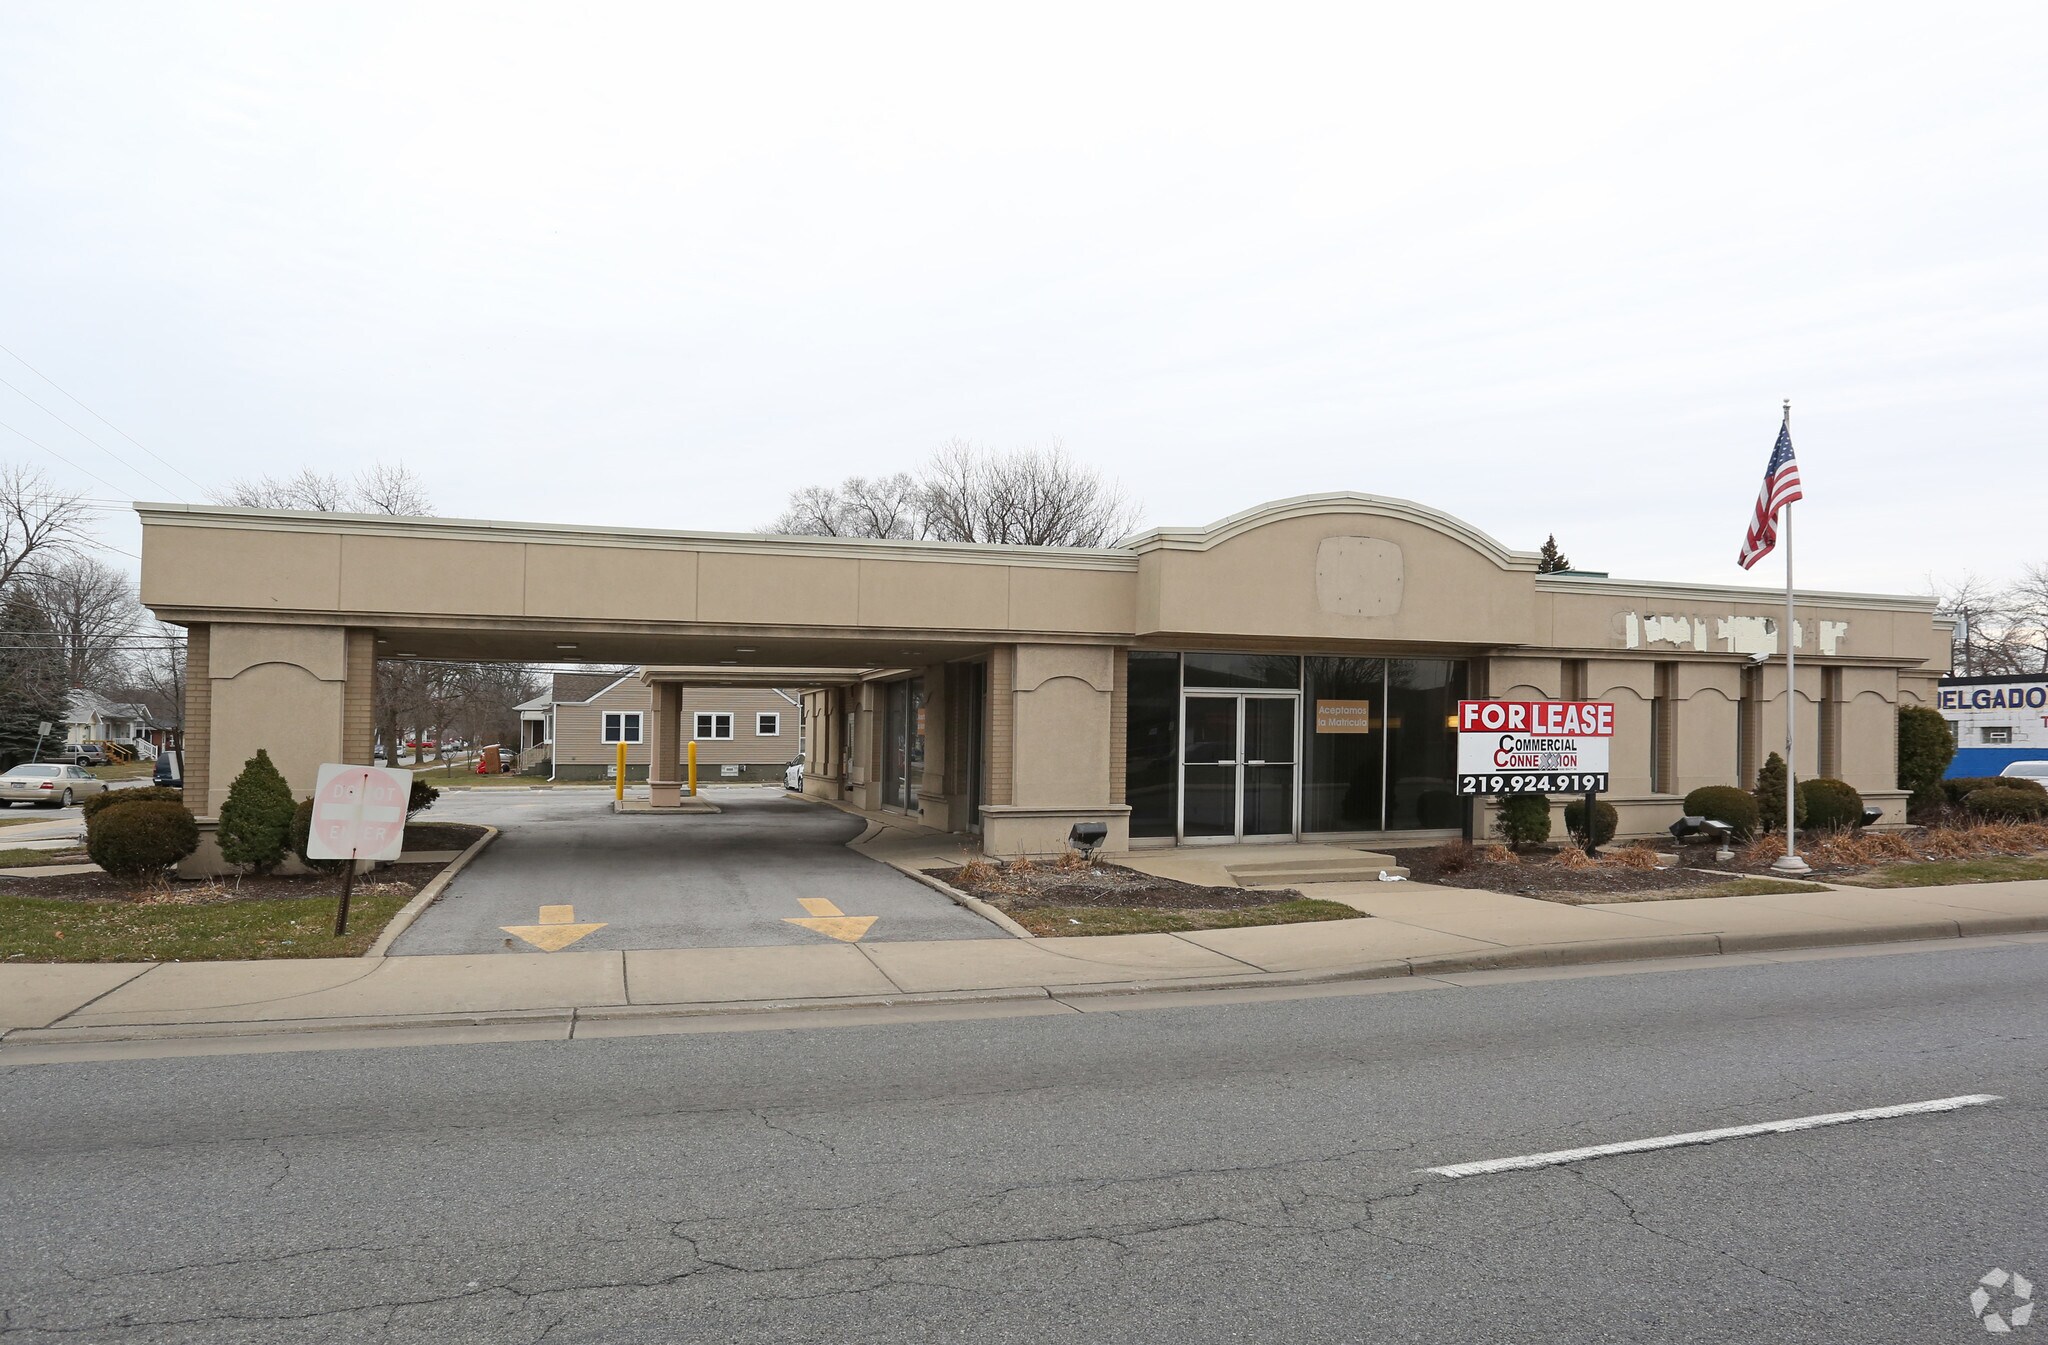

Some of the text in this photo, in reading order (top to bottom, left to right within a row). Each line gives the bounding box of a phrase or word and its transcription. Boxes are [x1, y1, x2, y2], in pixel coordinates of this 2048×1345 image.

[1937, 686, 2048, 709] ELGADO
[1318, 706, 1367, 715] Aceptamos
[1464, 703, 1613, 734] FOR LEASE
[1318, 718, 1326, 726] la
[1499, 734, 1577, 754] COMMERCIAL
[333, 784, 396, 801] DO OT
[1462, 775, 1605, 793] 219.924.9191
[330, 825, 387, 841] EER
